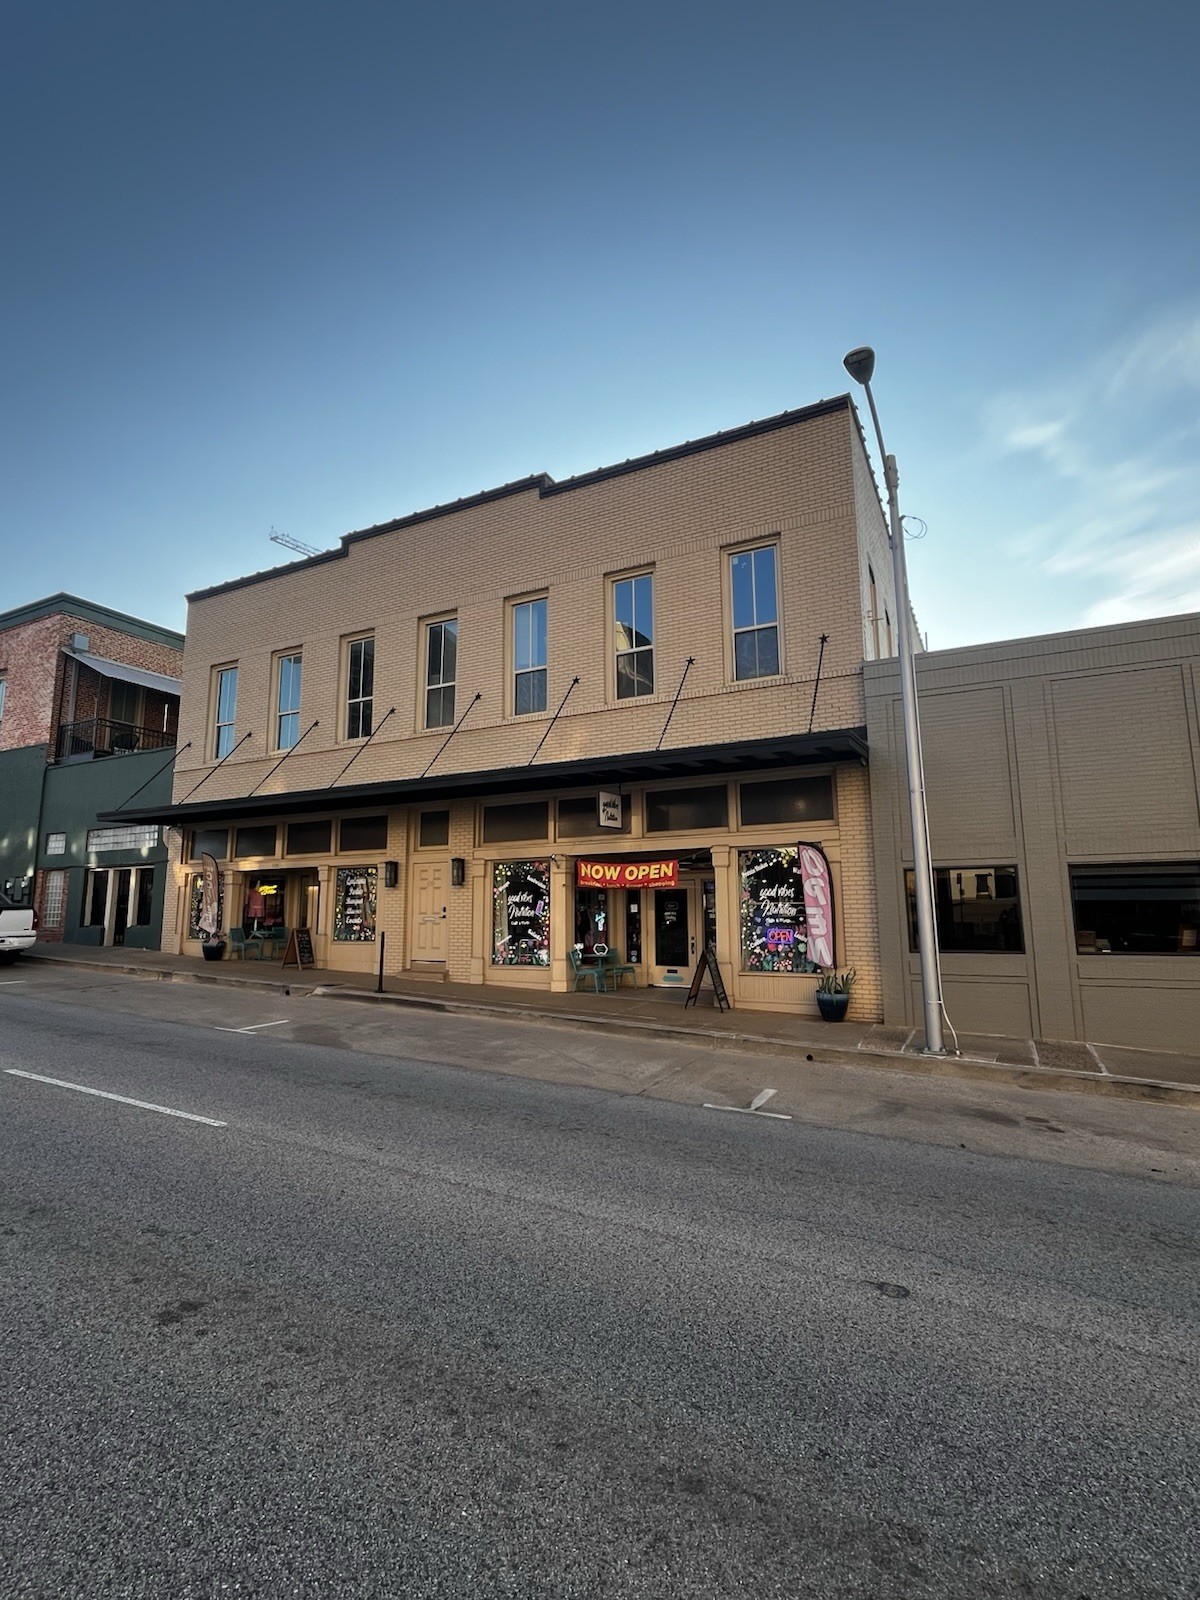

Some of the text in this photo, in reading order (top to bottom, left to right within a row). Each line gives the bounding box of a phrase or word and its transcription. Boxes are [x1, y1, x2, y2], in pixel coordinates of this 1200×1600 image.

[580, 862, 674, 881] NOW OPEN
[648, 880, 675, 888] shopping
[759, 883, 778, 901] good
[801, 849, 833, 969] OPEN
[768, 930, 791, 942] OPEN
